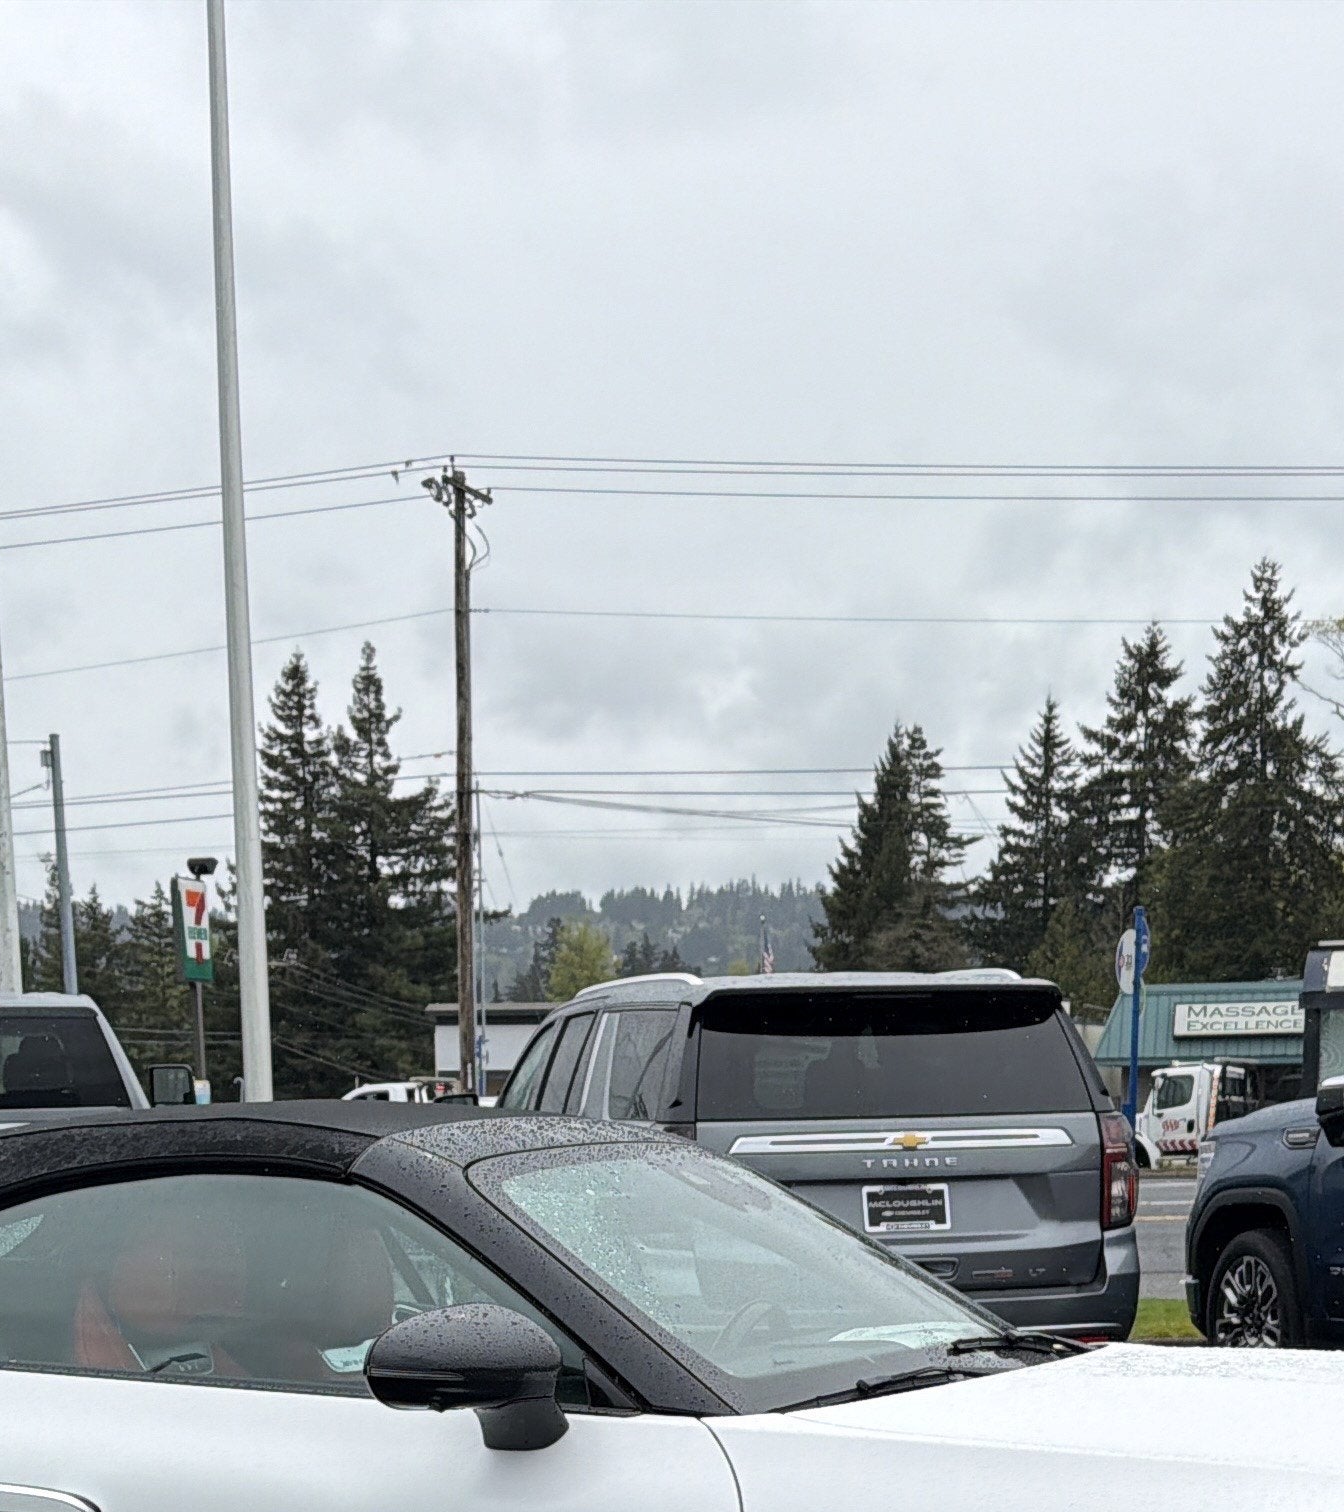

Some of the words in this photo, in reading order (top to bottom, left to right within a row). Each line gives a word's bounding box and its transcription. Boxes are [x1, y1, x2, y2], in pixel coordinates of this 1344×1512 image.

[1186, 1019, 1303, 1032] EXCELLENCE
[862, 1157, 958, 1168] TAHOE
[868, 1198, 944, 1209] MCLOUGHLIN
